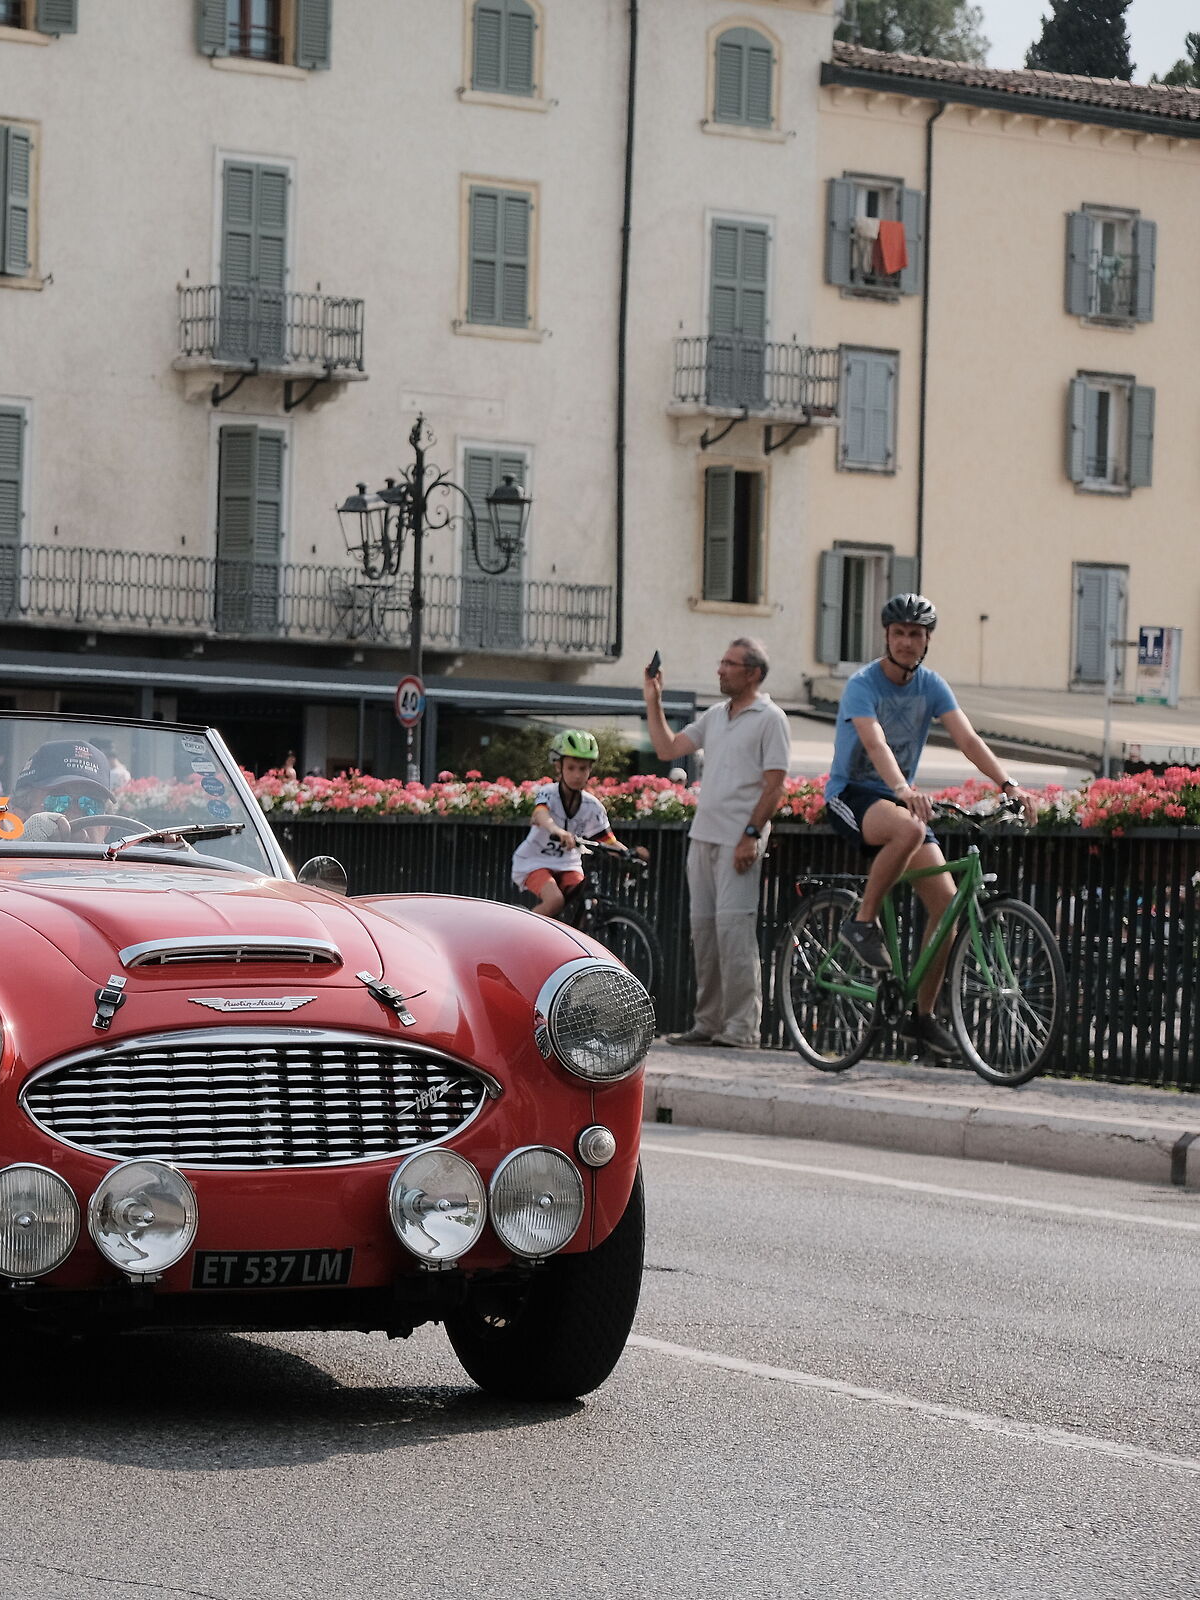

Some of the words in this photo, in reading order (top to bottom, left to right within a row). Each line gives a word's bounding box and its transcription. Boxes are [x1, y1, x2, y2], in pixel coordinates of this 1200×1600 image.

[401, 691, 419, 711] 40
[223, 999, 287, 1009] Austin-Healey
[202, 1256, 238, 1284] ET
[243, 1255, 296, 1284] 537
[302, 1253, 343, 1282] LM
